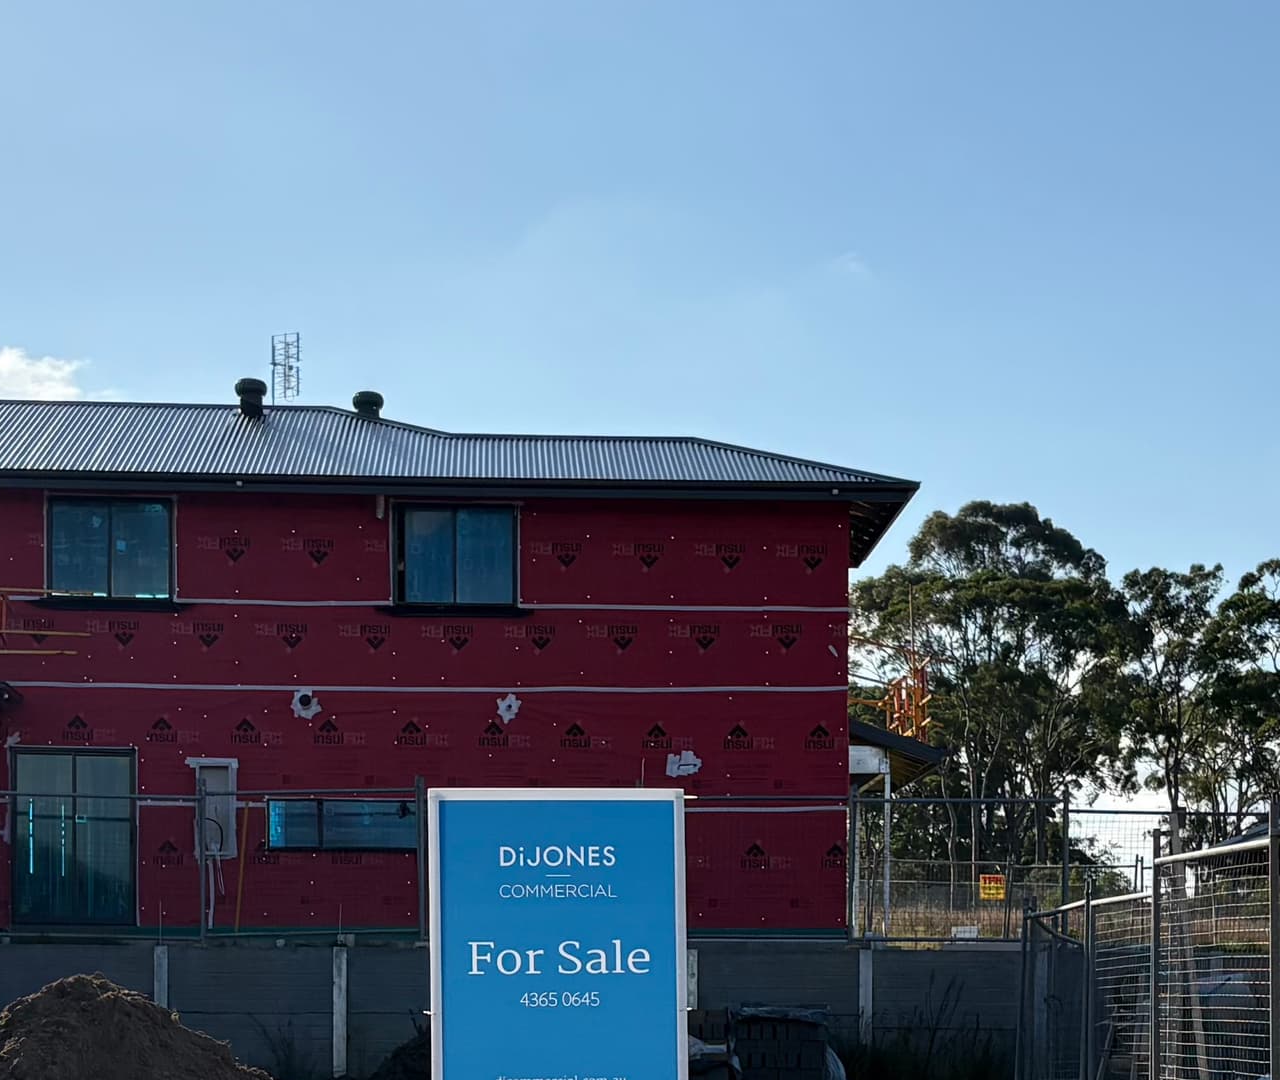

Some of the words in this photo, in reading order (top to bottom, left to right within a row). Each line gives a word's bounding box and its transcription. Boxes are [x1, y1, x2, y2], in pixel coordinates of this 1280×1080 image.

[499, 846, 616, 867] DiJONES
[499, 884, 617, 898] COMMERCIAL
[468, 940, 545, 975] For
[558, 939, 651, 975] Sale
[520, 992, 558, 1007] 4365
[562, 992, 600, 1007] 0645
